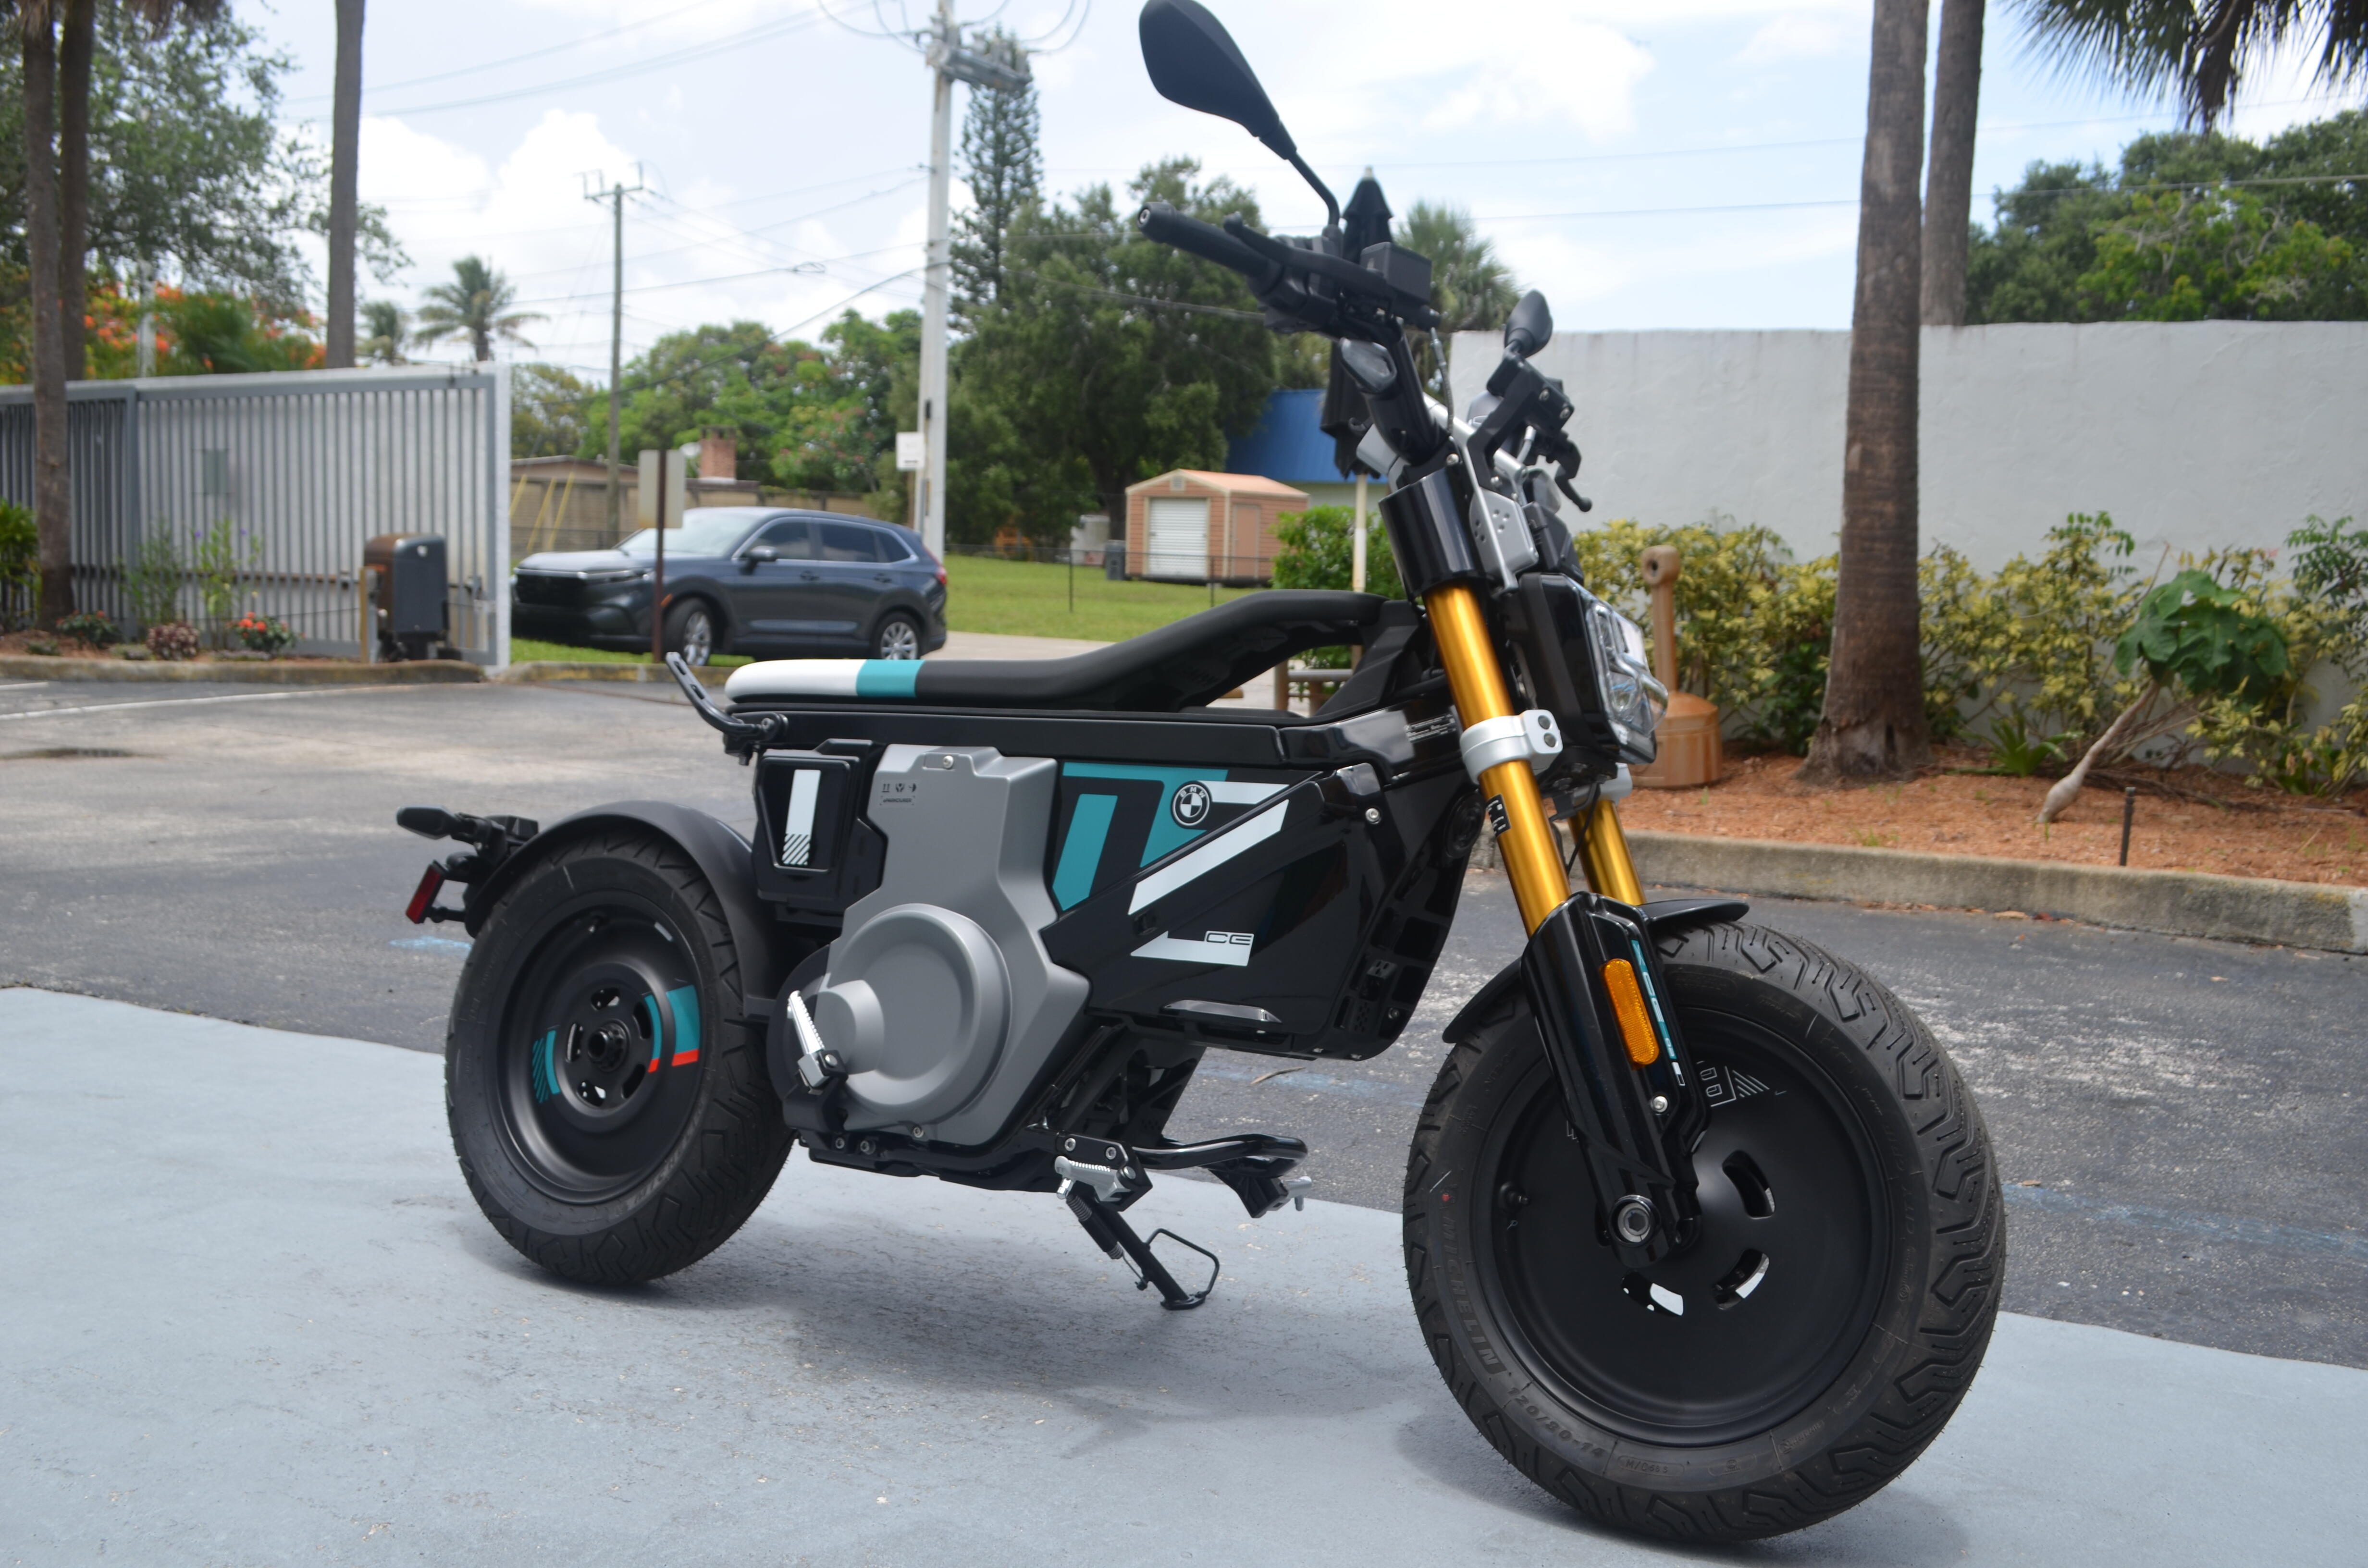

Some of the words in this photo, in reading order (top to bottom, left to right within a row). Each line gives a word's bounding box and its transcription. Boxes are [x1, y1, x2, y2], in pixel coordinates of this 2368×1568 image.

[1180, 787, 1206, 798] BMW
[1206, 932, 1252, 945] CE
[1442, 1217, 1500, 1368] MICHELIN
[1507, 1386, 1607, 1459] 120/80-14
